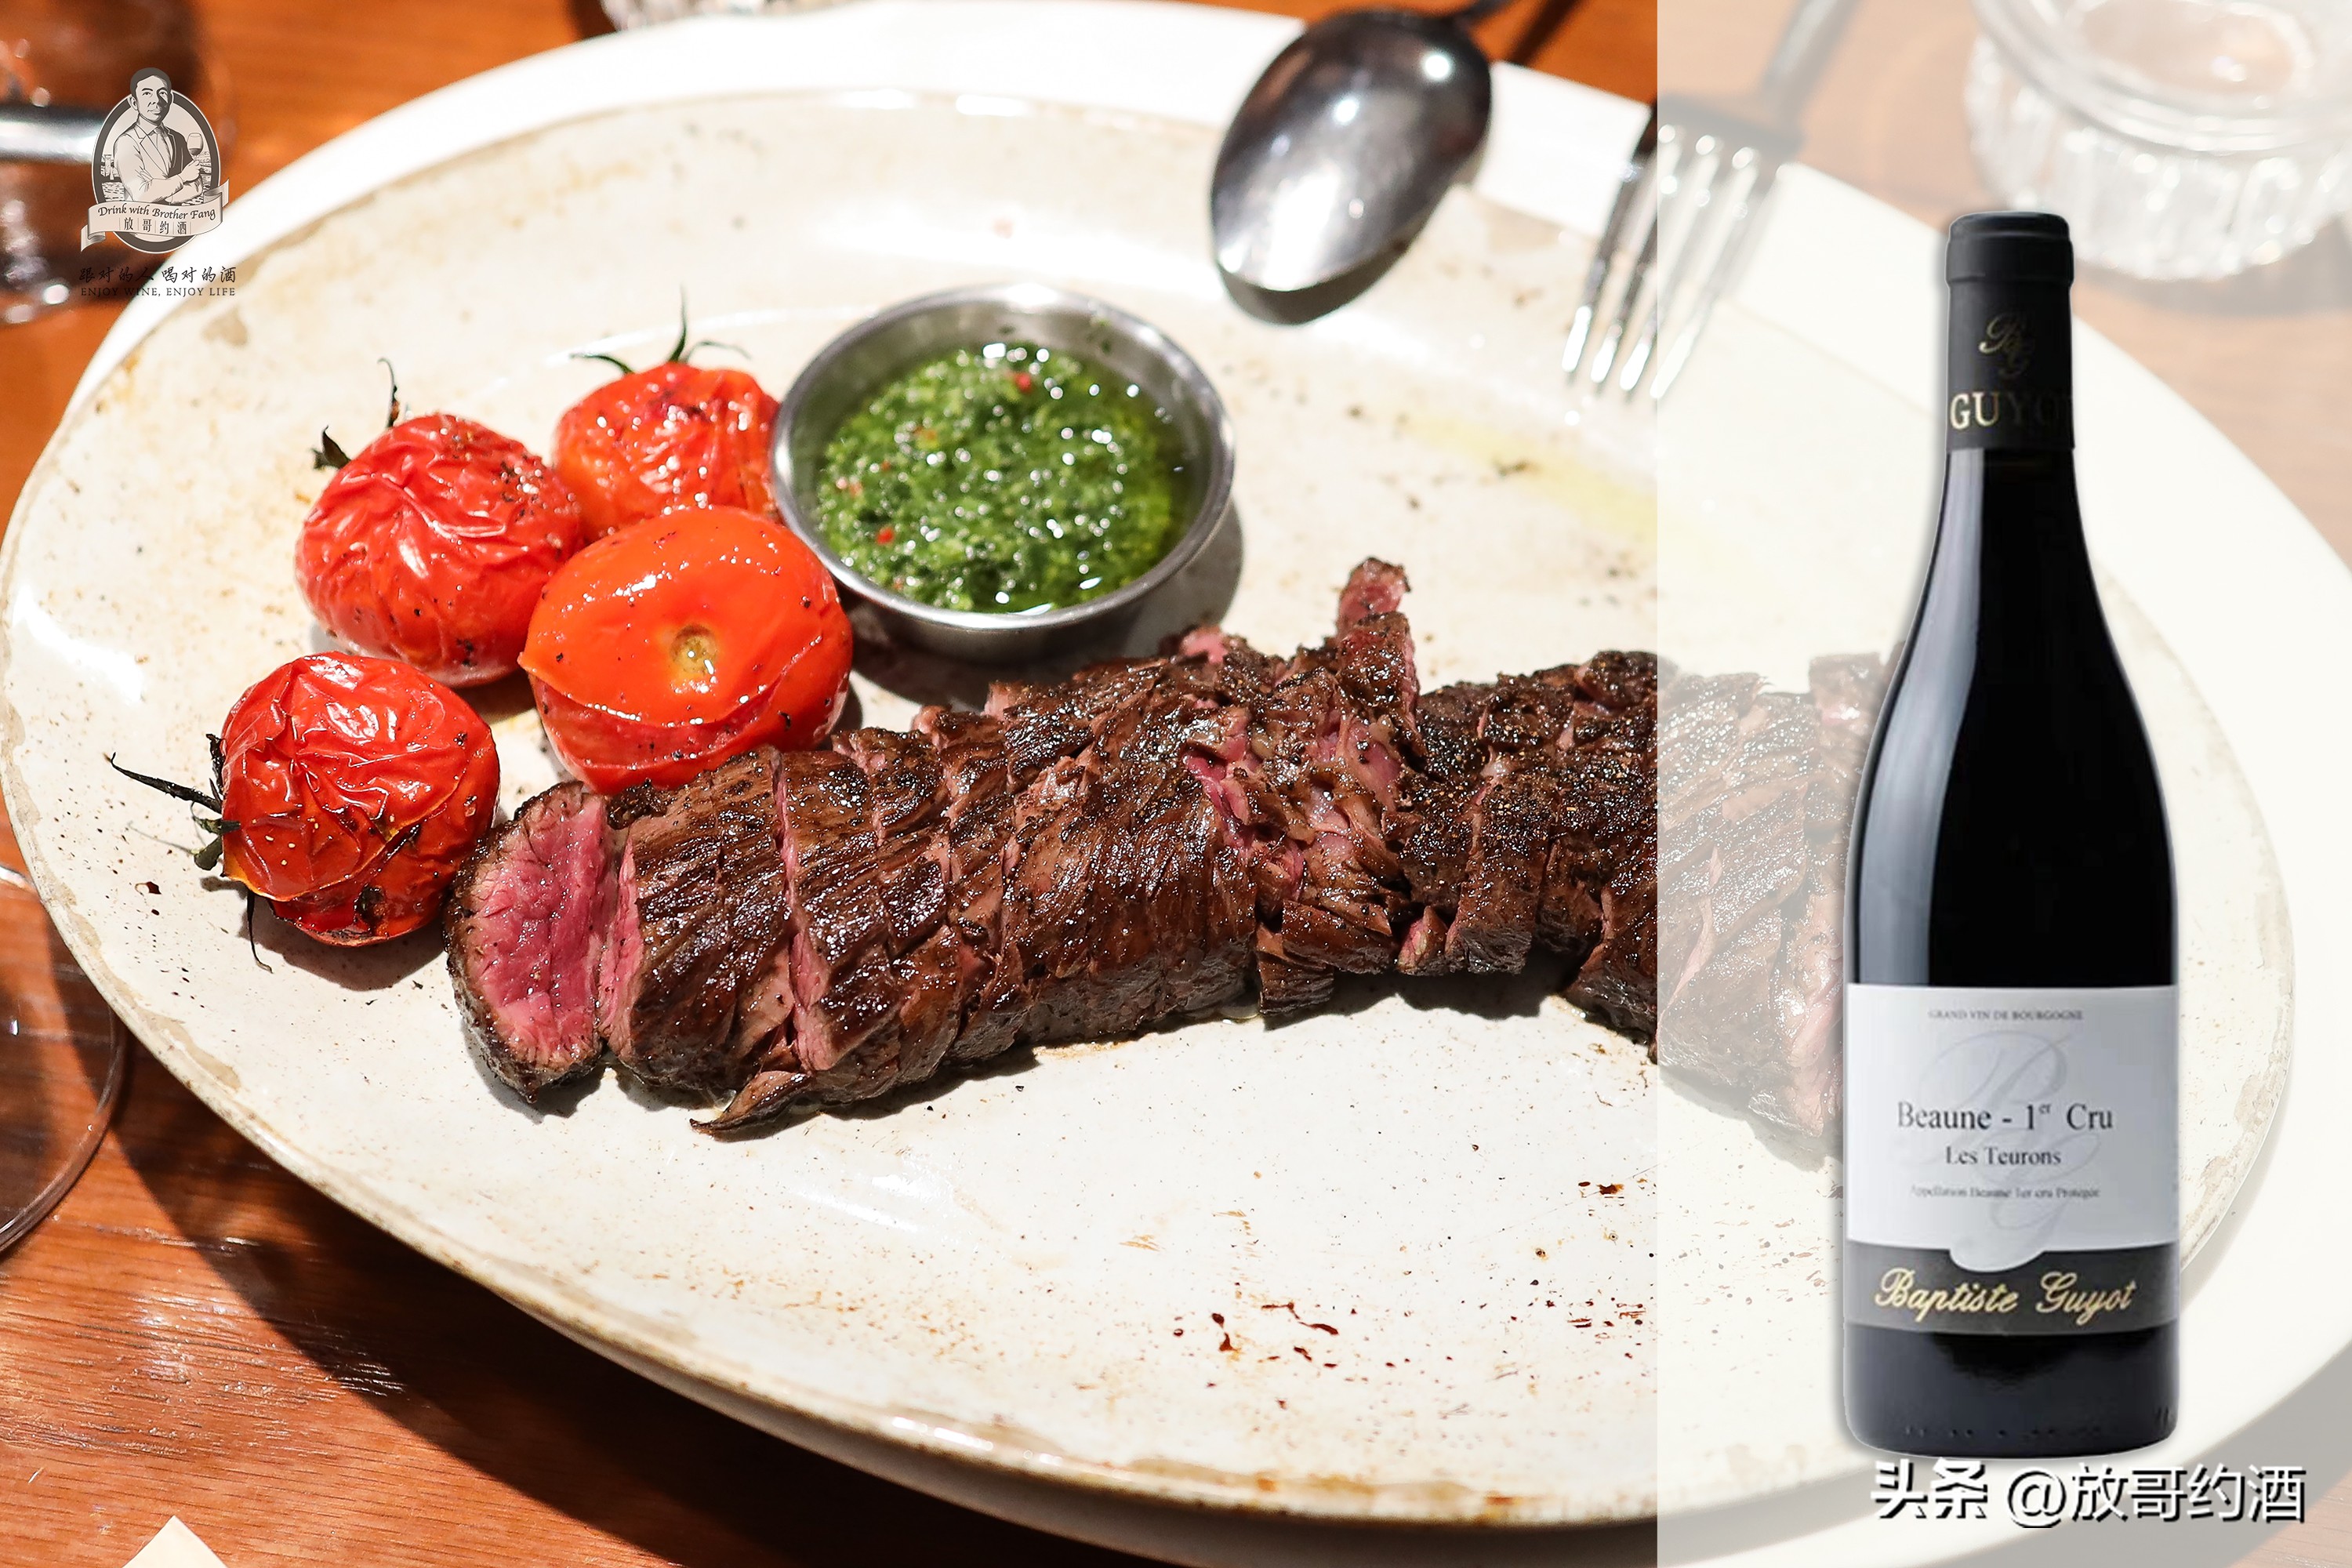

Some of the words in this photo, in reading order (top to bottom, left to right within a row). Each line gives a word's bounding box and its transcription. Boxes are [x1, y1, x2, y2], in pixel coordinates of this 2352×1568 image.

[1928, 1010, 1968, 1020] GRAND
[1969, 1010, 1990, 1020] VIN
[1993, 1010, 2008, 1020] DE
[2011, 1010, 2083, 1020] BOURGOGNE
[1898, 1102, 1992, 1130] Beaune
[2026, 1102, 2051, 1130] 1er
[2067, 1102, 2113, 1131] Cru
[1946, 1146, 1978, 1165] Les
[1985, 1146, 2062, 1165] Teurons
[1875, 1268, 2019, 1323] Baptiste
[2036, 1271, 2136, 1326] Guyot
